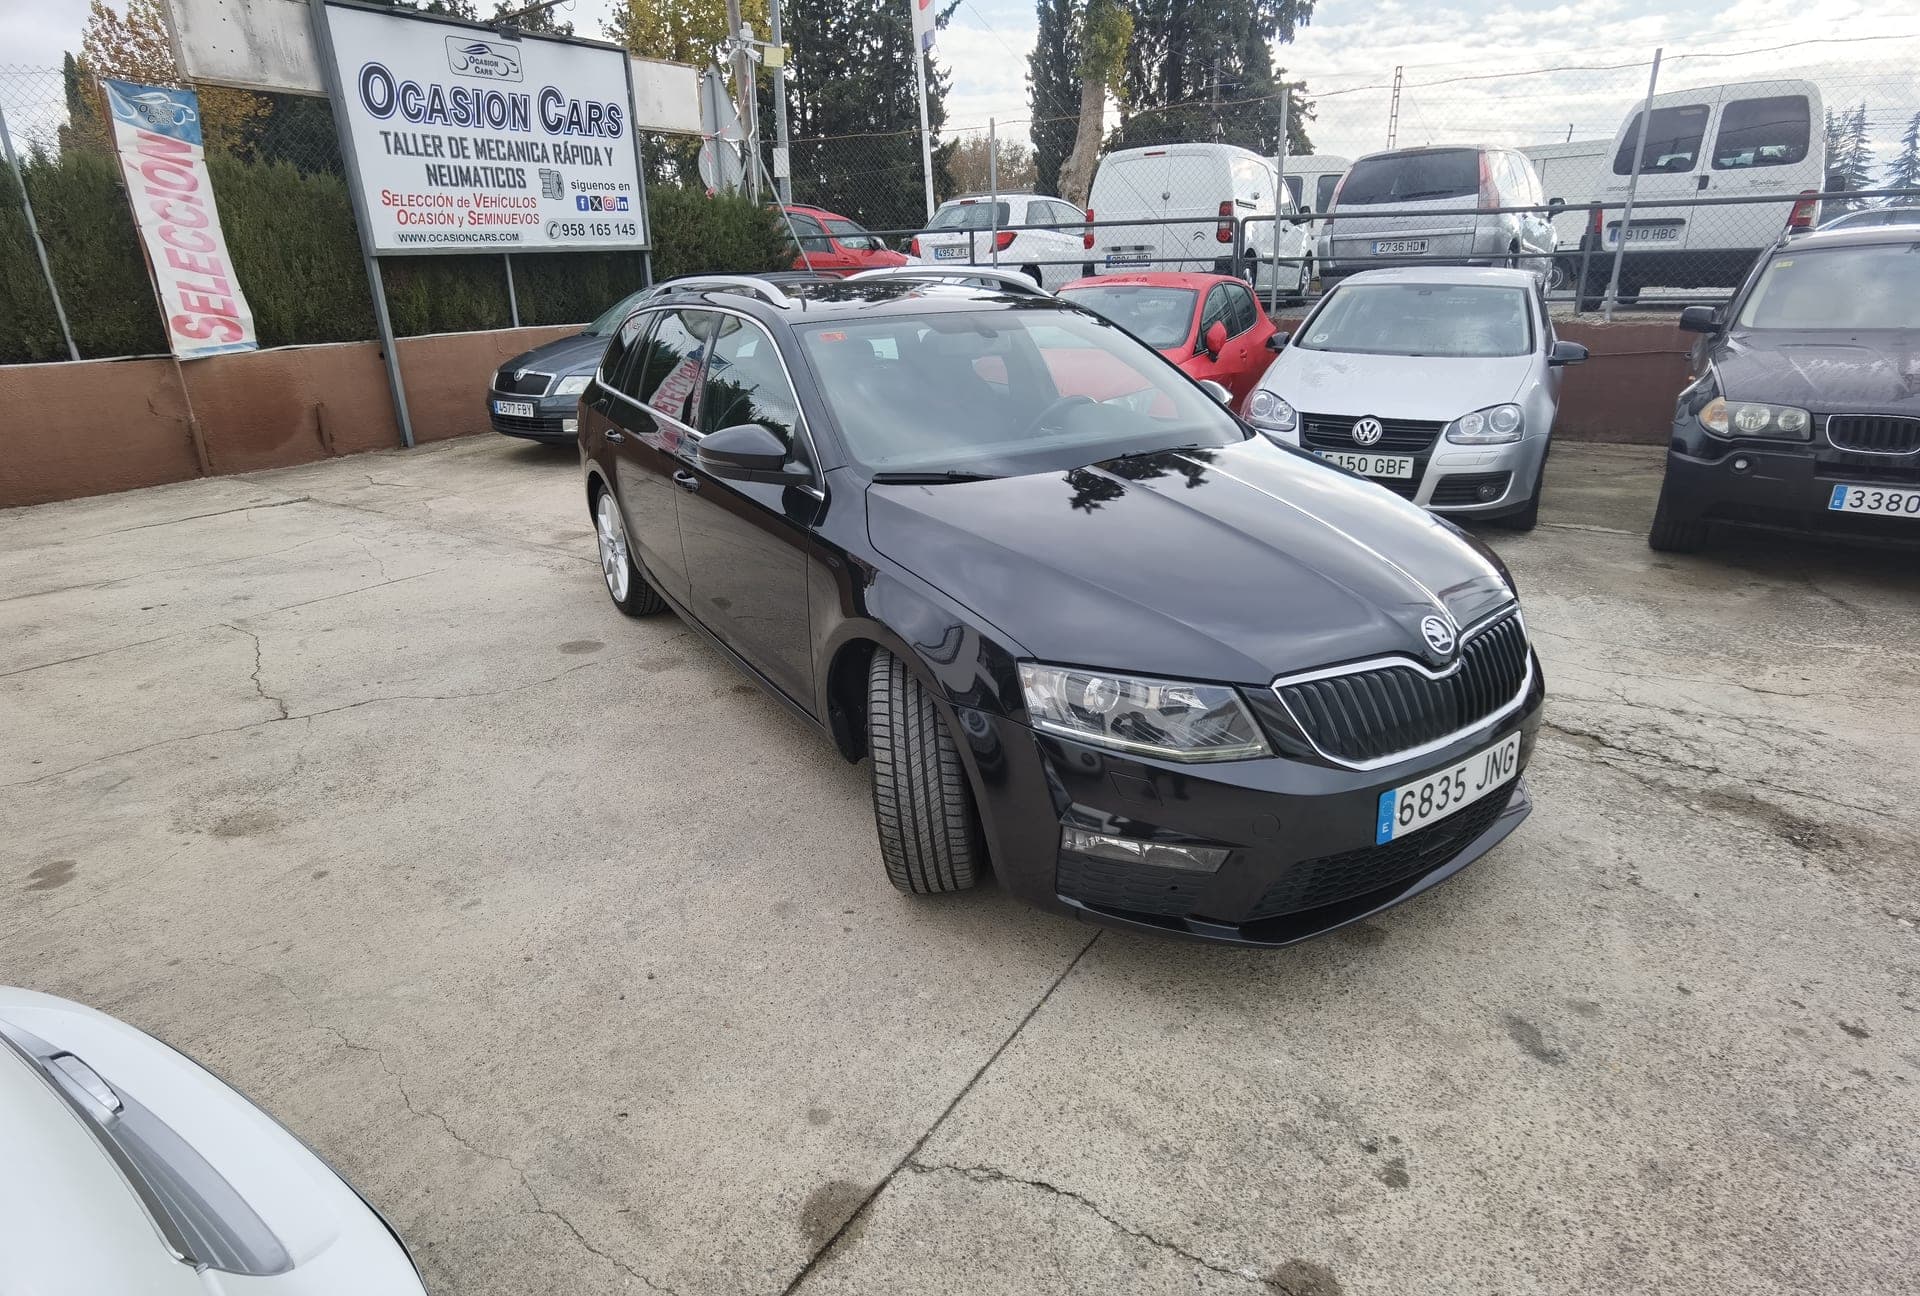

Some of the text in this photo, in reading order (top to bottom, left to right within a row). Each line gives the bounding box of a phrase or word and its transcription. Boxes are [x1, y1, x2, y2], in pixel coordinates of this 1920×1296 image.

[358, 61, 623, 140] OCASION CARS
[379, 130, 613, 167] TALLER DE MECANICA RÁPIDA Y
[425, 163, 527, 189] NEUMATICOS
[618, 183, 630, 191] en
[456, 196, 470, 208] de
[458, 215, 464, 228] y
[127, 129, 245, 343] SELECCIÓN
[562, 223, 636, 236] 958 165 145
[1652, 228, 1677, 240] HBC
[398, 233, 520, 242] WWW.OCASIONCARS.COM
[938, 248, 954, 257] 4952
[1379, 240, 1426, 252] 2736 HDW
[498, 400, 532, 416] 4577 FBY
[1374, 458, 1409, 475] GBF
[1849, 490, 1920, 514] 3380
[1398, 741, 1515, 826] 6835 JNG
[1382, 822, 1389, 834] E
